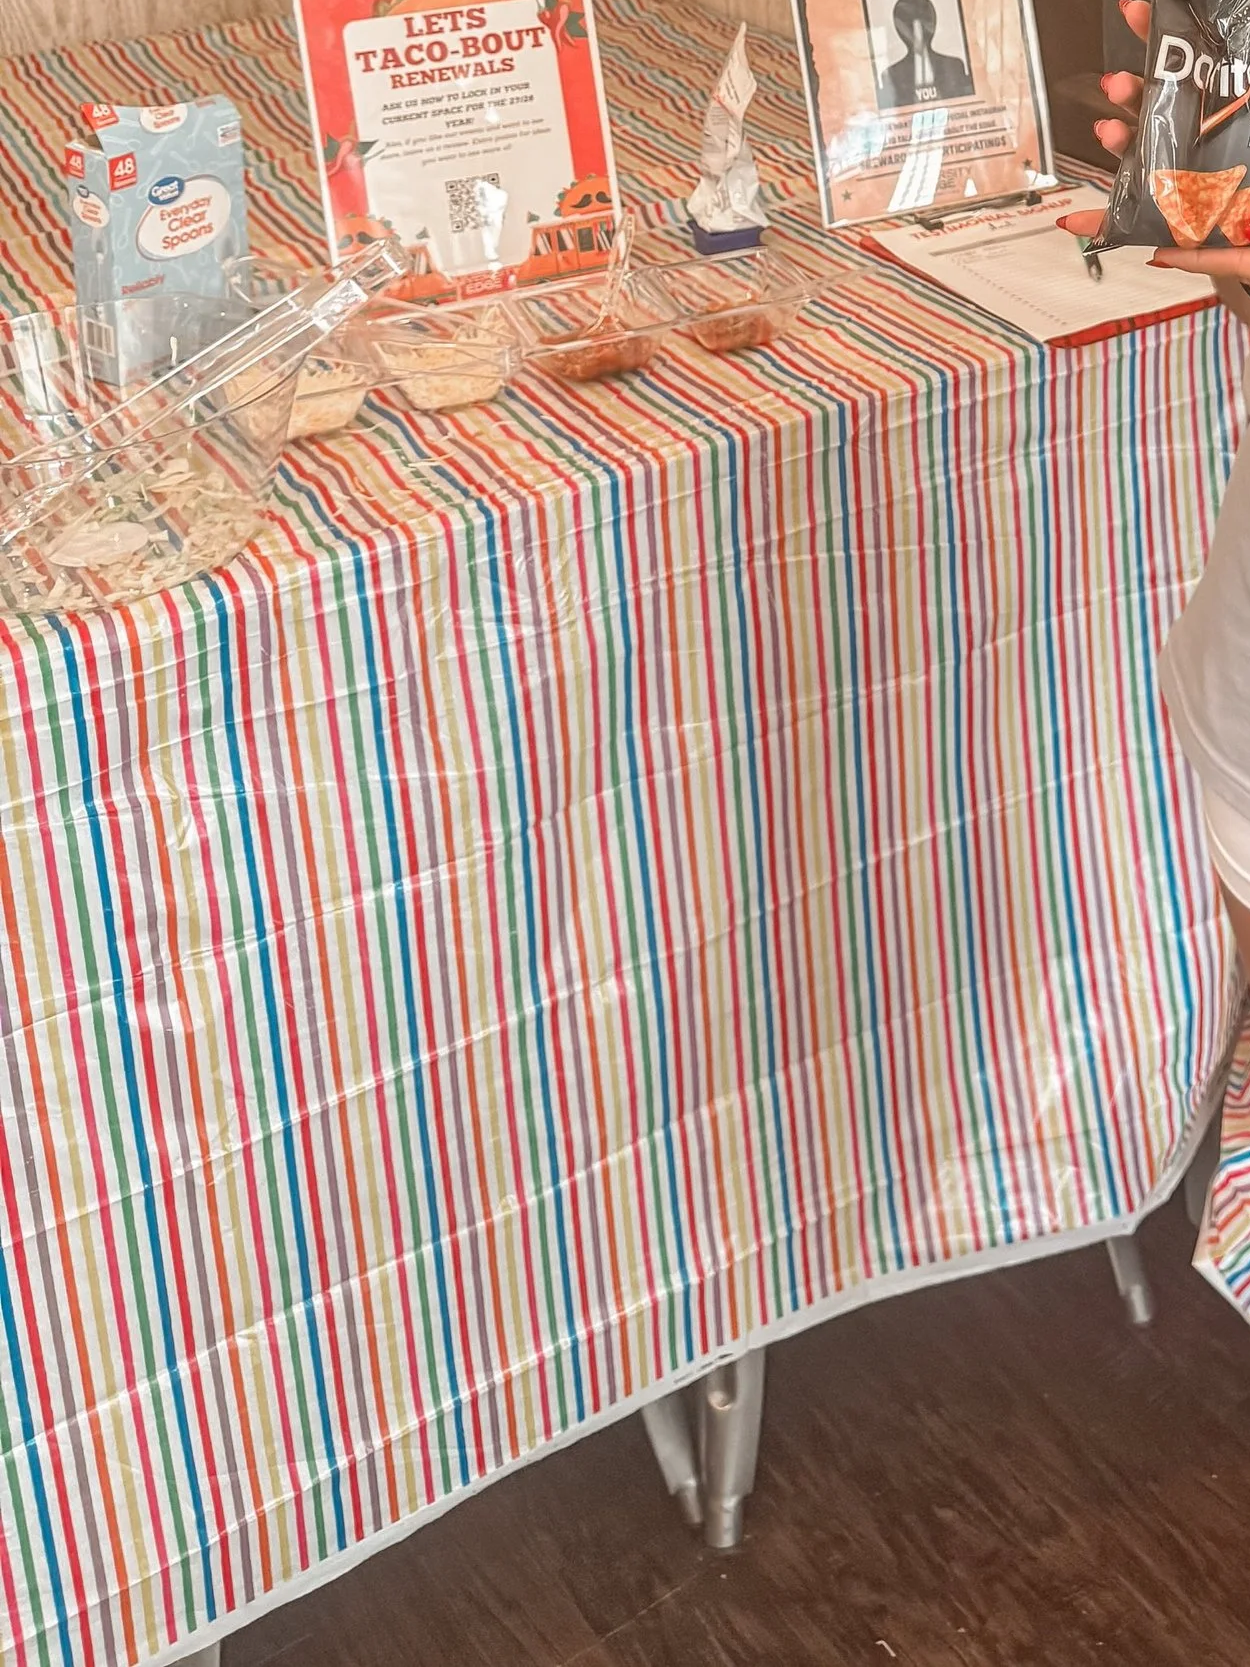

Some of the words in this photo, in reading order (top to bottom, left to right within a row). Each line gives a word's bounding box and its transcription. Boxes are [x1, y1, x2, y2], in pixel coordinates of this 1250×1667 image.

[404, 7, 487, 37] LETS
[355, 26, 546, 72] TACO-BOUT
[390, 57, 515, 89] RENEWALS
[915, 88, 937, 100] YOU
[69, 154, 82, 169] 48
[113, 158, 135, 177] 48
[160, 195, 212, 221] Everyday
[168, 210, 207, 232] Clear
[162, 223, 213, 250] Spoons
